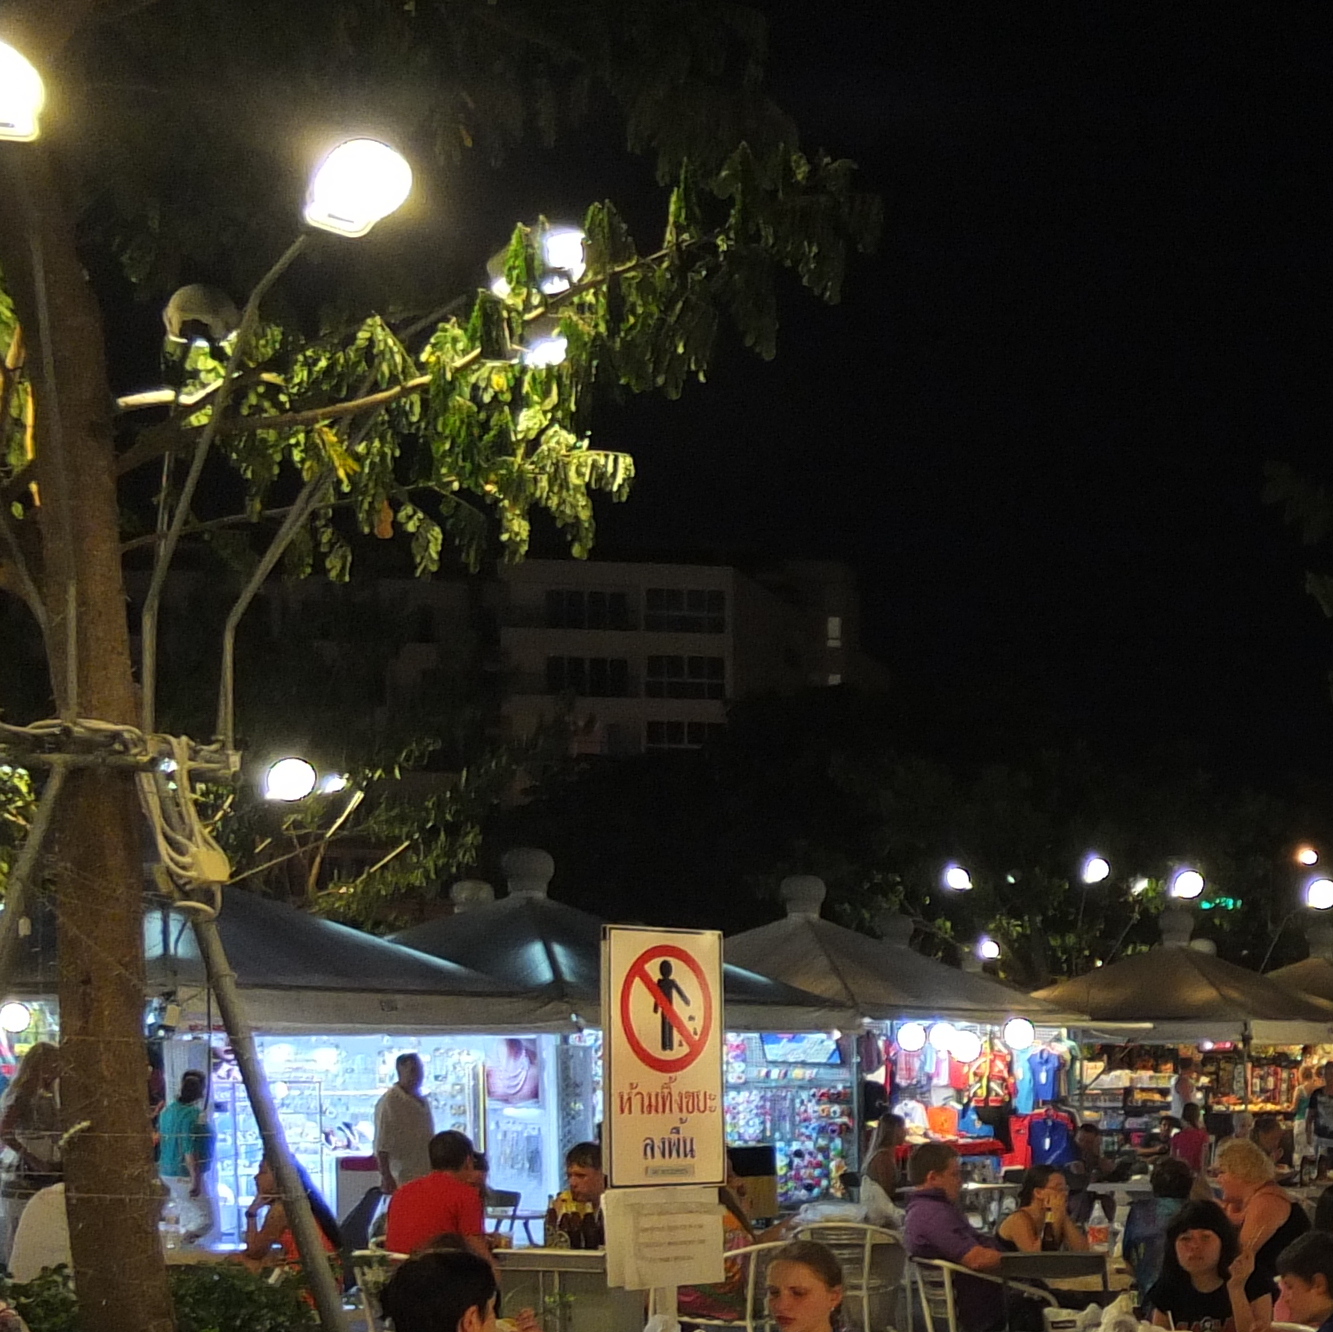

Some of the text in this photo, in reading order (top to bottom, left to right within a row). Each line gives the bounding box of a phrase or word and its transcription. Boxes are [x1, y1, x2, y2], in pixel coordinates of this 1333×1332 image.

[618, 1075, 717, 1115] ห้ามทิ้งขยะ
[643, 1117, 696, 1160] ลงพื้น
